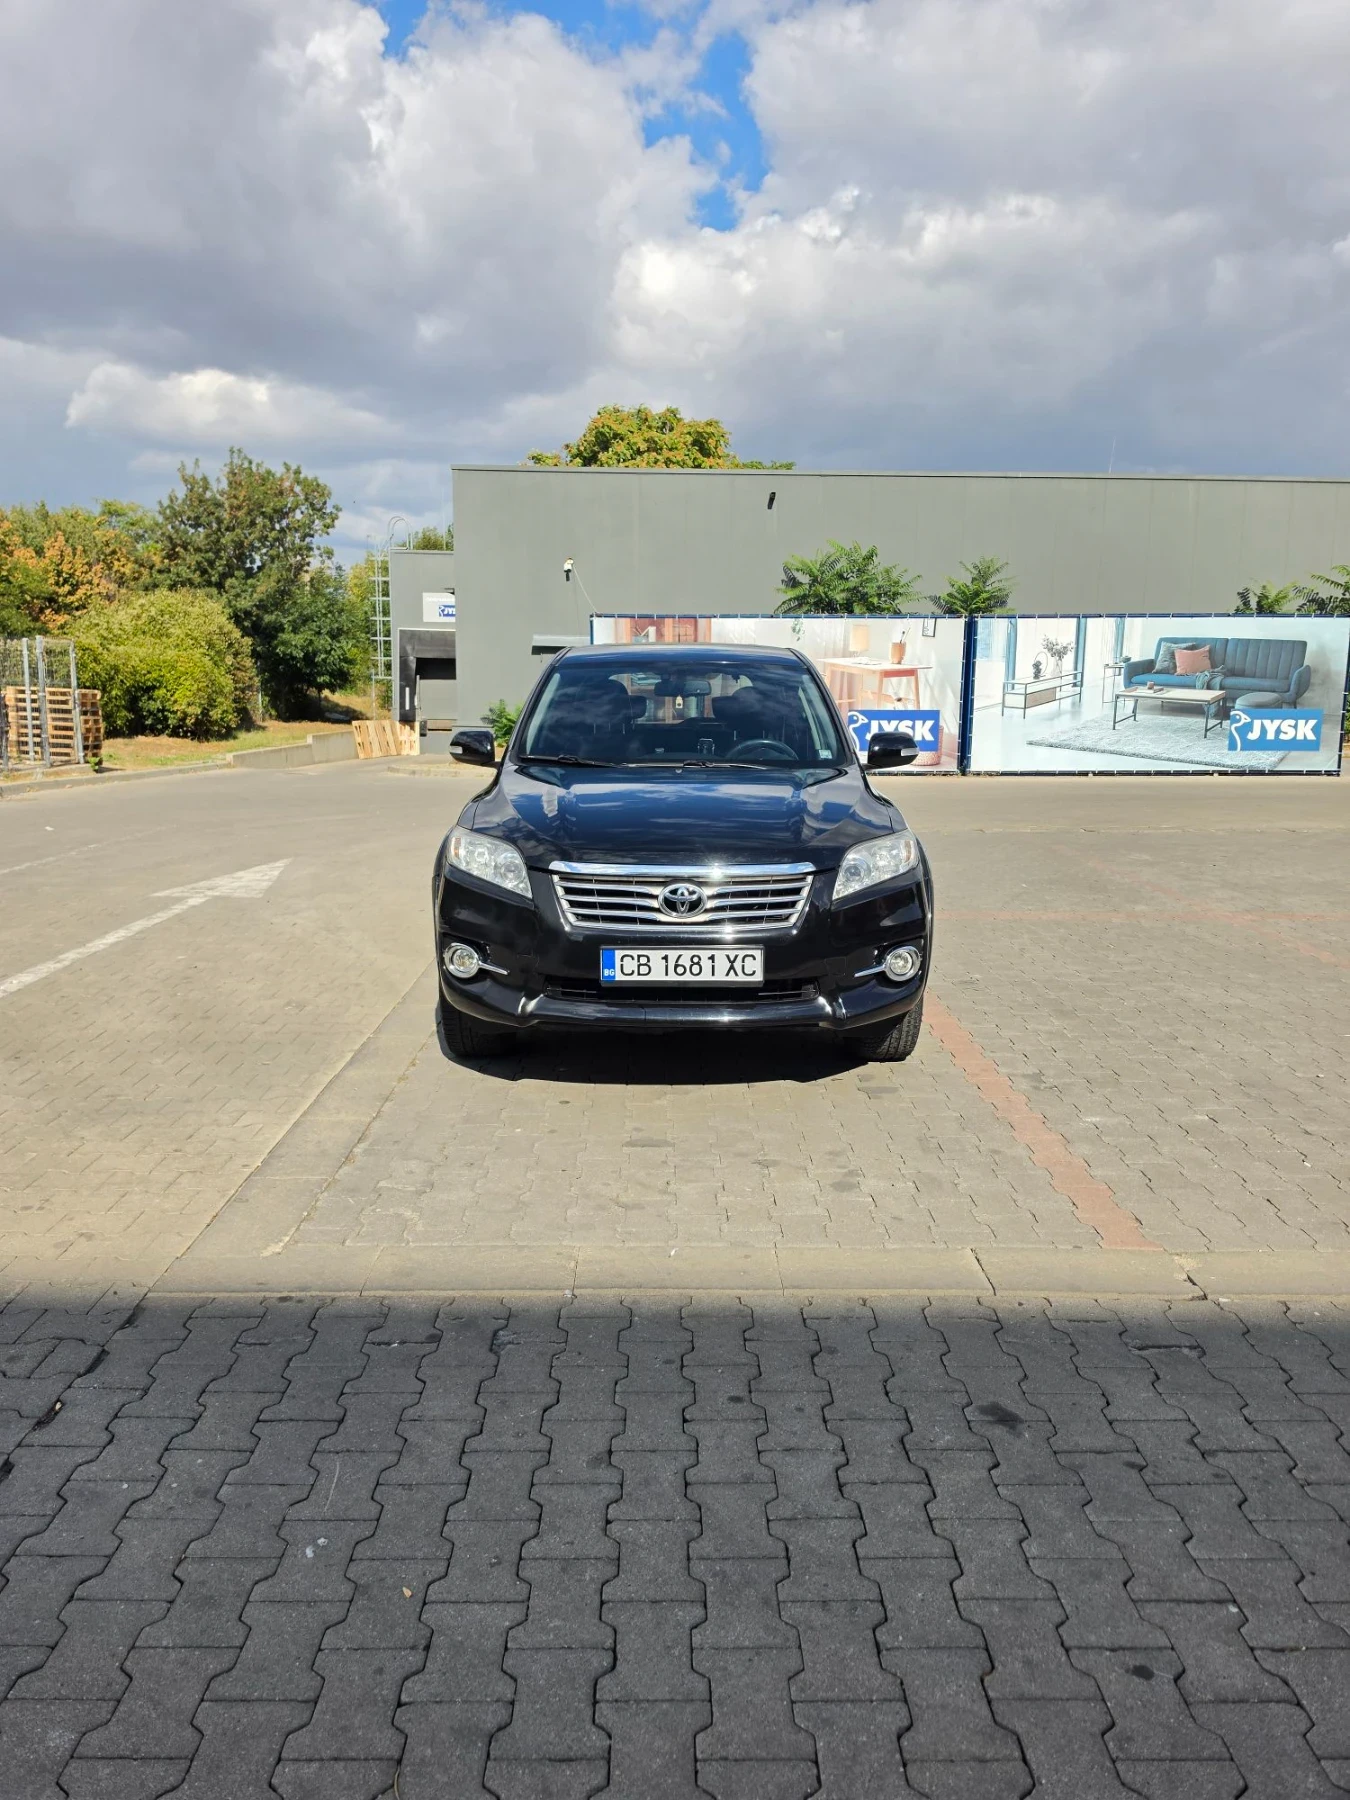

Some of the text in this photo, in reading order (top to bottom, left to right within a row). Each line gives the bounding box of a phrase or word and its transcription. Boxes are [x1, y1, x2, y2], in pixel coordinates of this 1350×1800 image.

[865, 719, 935, 741] JYSK
[1246, 719, 1318, 740] JYSK
[604, 968, 615, 976] BG
[620, 954, 757, 977] CB 1681 XC
